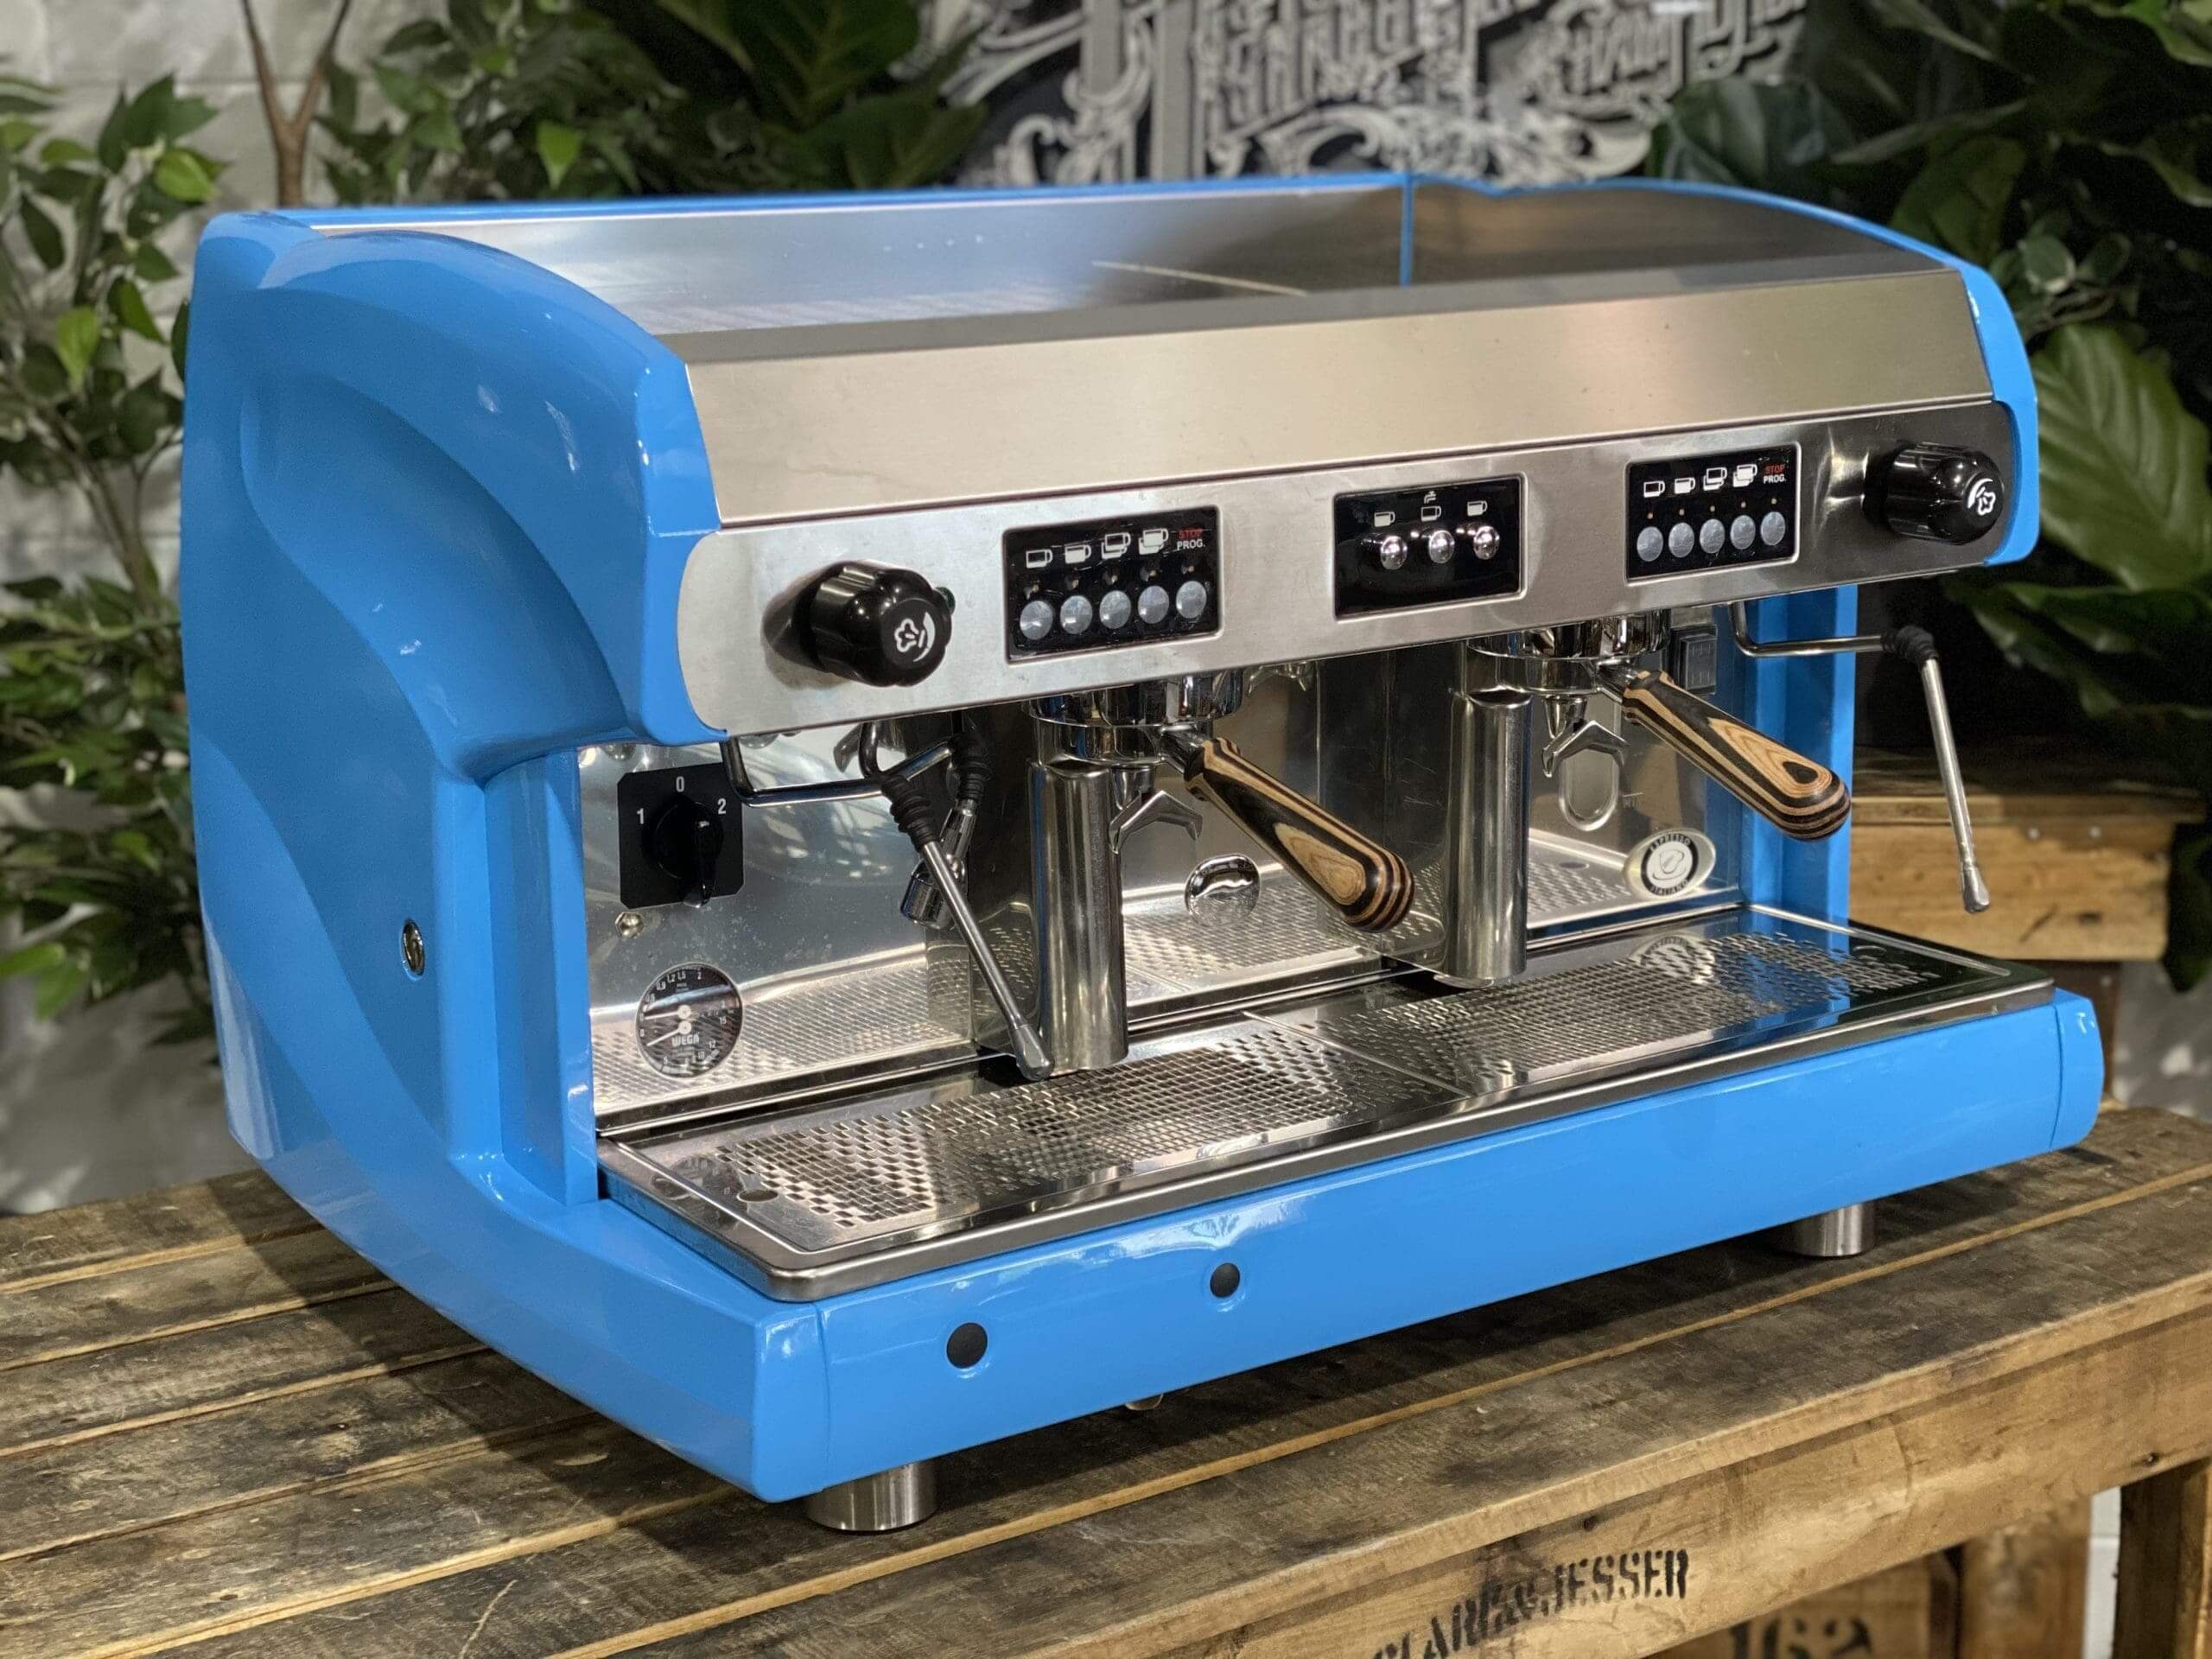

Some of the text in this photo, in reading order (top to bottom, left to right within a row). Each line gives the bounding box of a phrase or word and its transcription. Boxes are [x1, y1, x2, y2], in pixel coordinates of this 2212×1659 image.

[1764, 464, 1785, 474] STOP
[1178, 530, 1203, 539] STOP
[1177, 539, 1205, 550] PROG.
[676, 776, 684, 792] 0
[717, 798, 727, 815] 2
[637, 808, 644, 824] 1
[671, 1035, 699, 1046] WEGA
